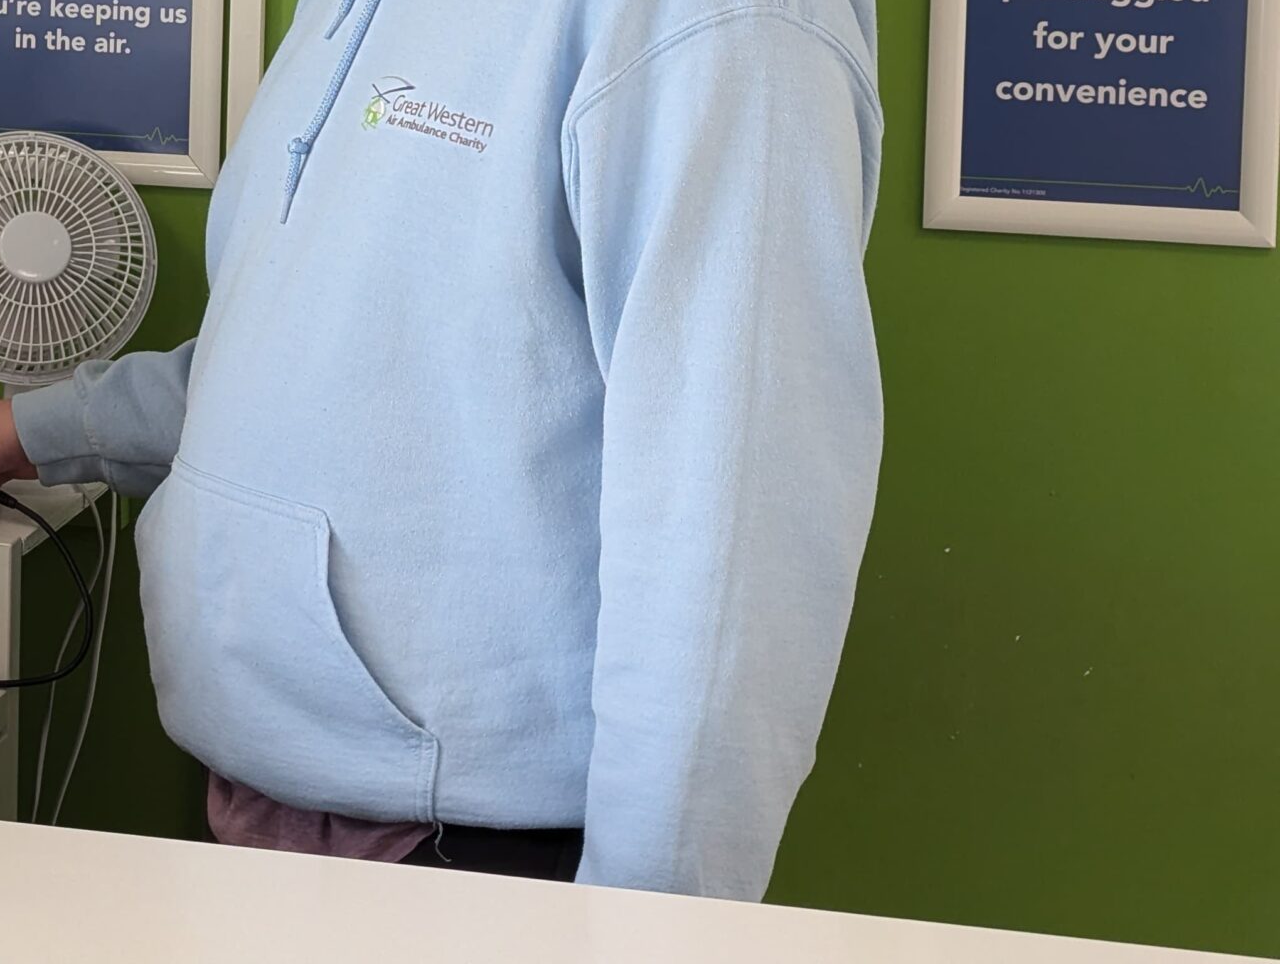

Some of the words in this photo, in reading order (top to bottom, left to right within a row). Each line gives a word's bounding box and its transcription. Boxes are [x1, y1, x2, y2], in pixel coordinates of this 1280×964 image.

[159, 5, 188, 25] us
[15, 27, 37, 50] in
[44, 29, 87, 53] the
[94, 32, 132, 55] air.
[1033, 21, 1085, 51] for
[1094, 32, 1175, 60] your
[995, 79, 1210, 109] convenience
[392, 94, 426, 117] Great
[427, 101, 494, 137] Western
[386, 114, 397, 126] Air
[397, 118, 447, 140] Ambulance
[449, 132, 487, 153] Charity
